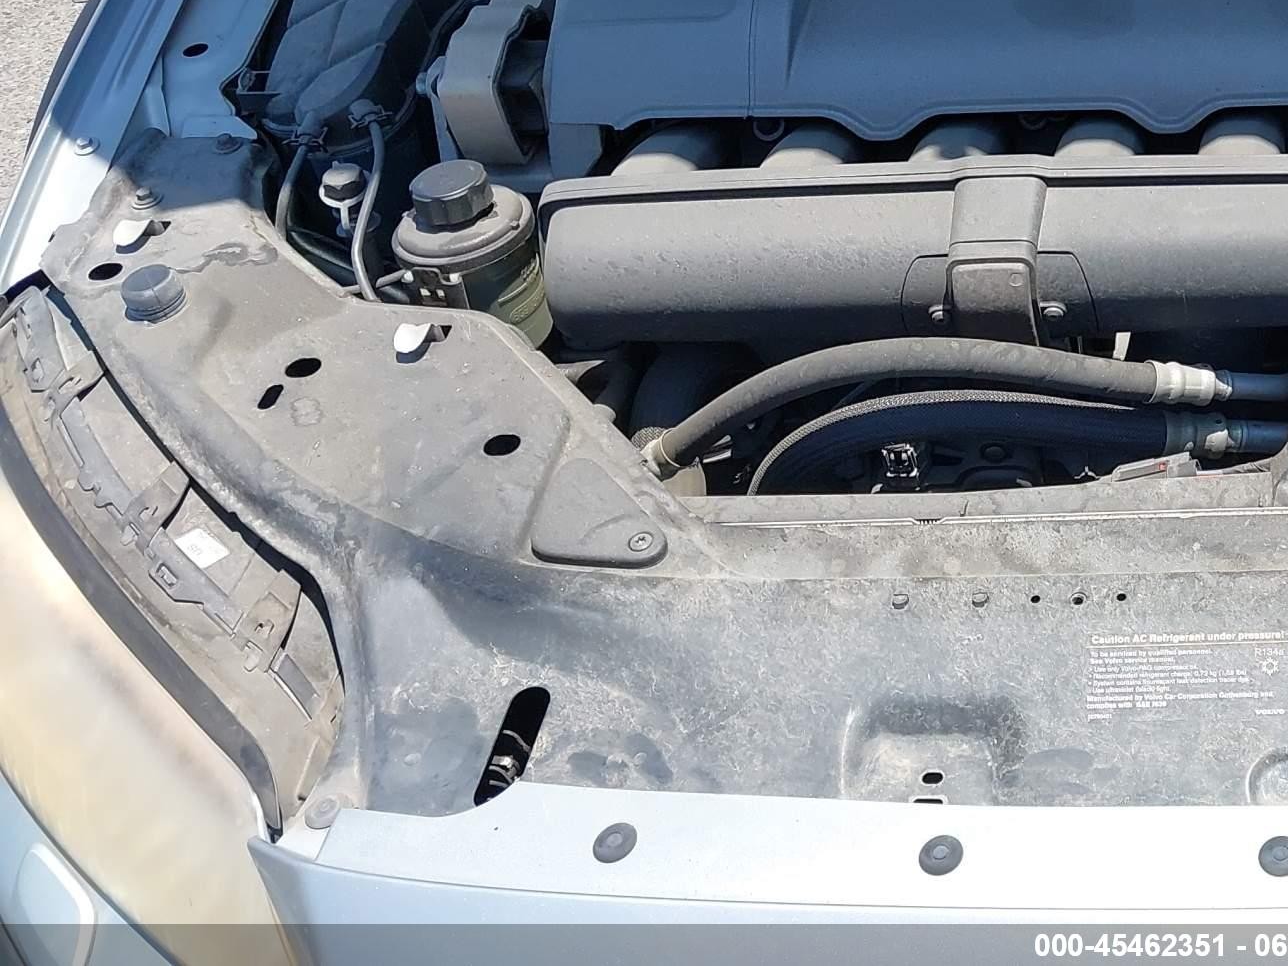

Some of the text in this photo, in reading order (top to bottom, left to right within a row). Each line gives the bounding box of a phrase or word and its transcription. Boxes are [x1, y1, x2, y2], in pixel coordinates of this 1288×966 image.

[1091, 630, 1285, 644] Caution AC Refrigerant under pressure!
